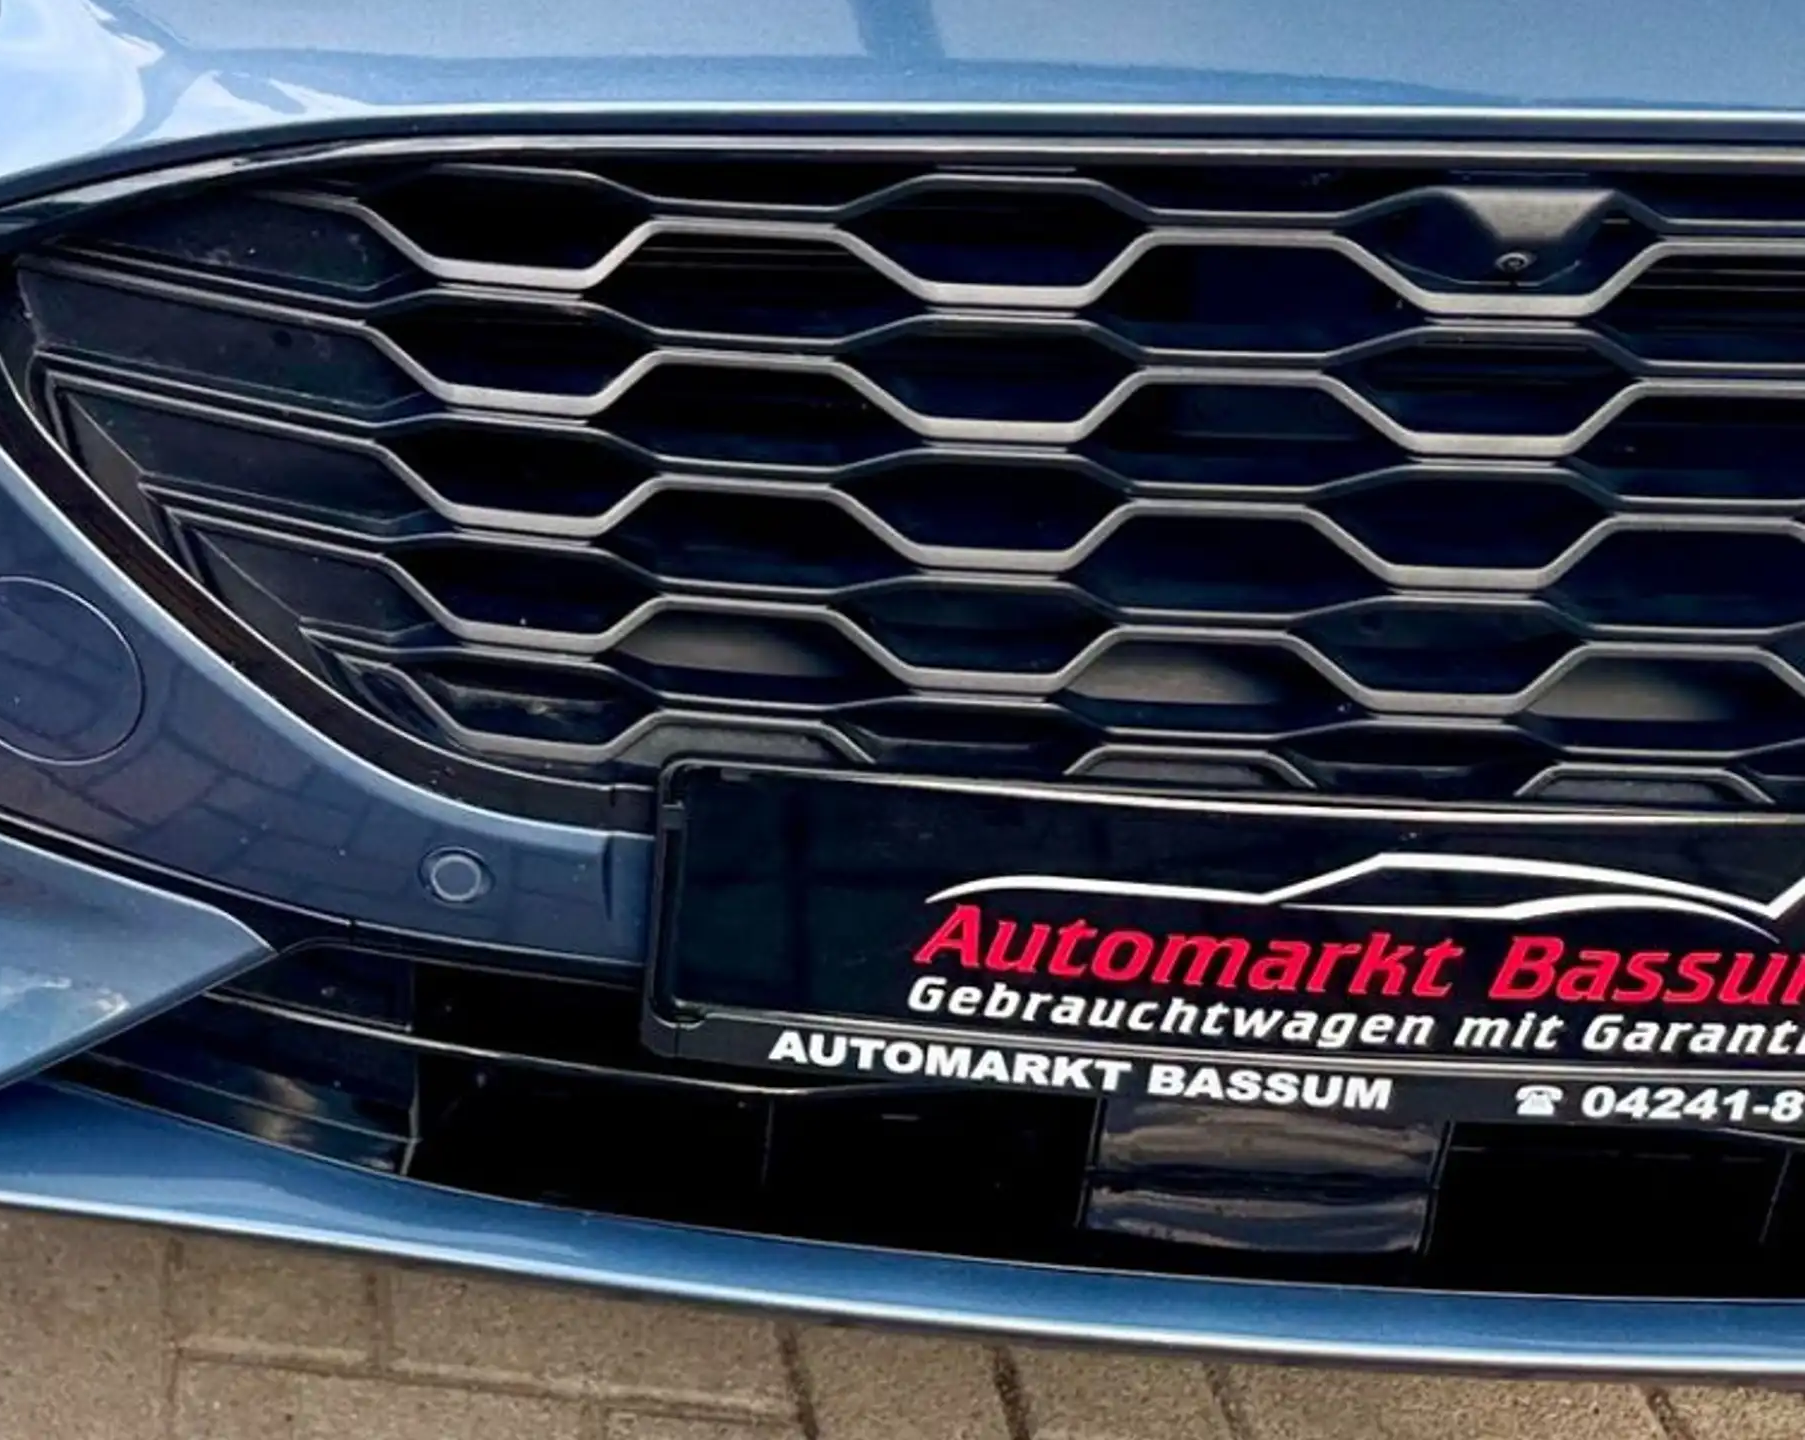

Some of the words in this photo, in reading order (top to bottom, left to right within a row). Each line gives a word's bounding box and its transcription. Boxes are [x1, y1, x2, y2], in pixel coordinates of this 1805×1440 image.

[912, 903, 1466, 1000] Automarkt
[1487, 934, 1805, 1005] Bassu
[907, 975, 1437, 1048] Gebrauchtwagen
[1452, 1011, 1564, 1050] mit
[768, 1030, 1132, 1092] AUTOMARKT
[1147, 1063, 1394, 1111] BASSUM
